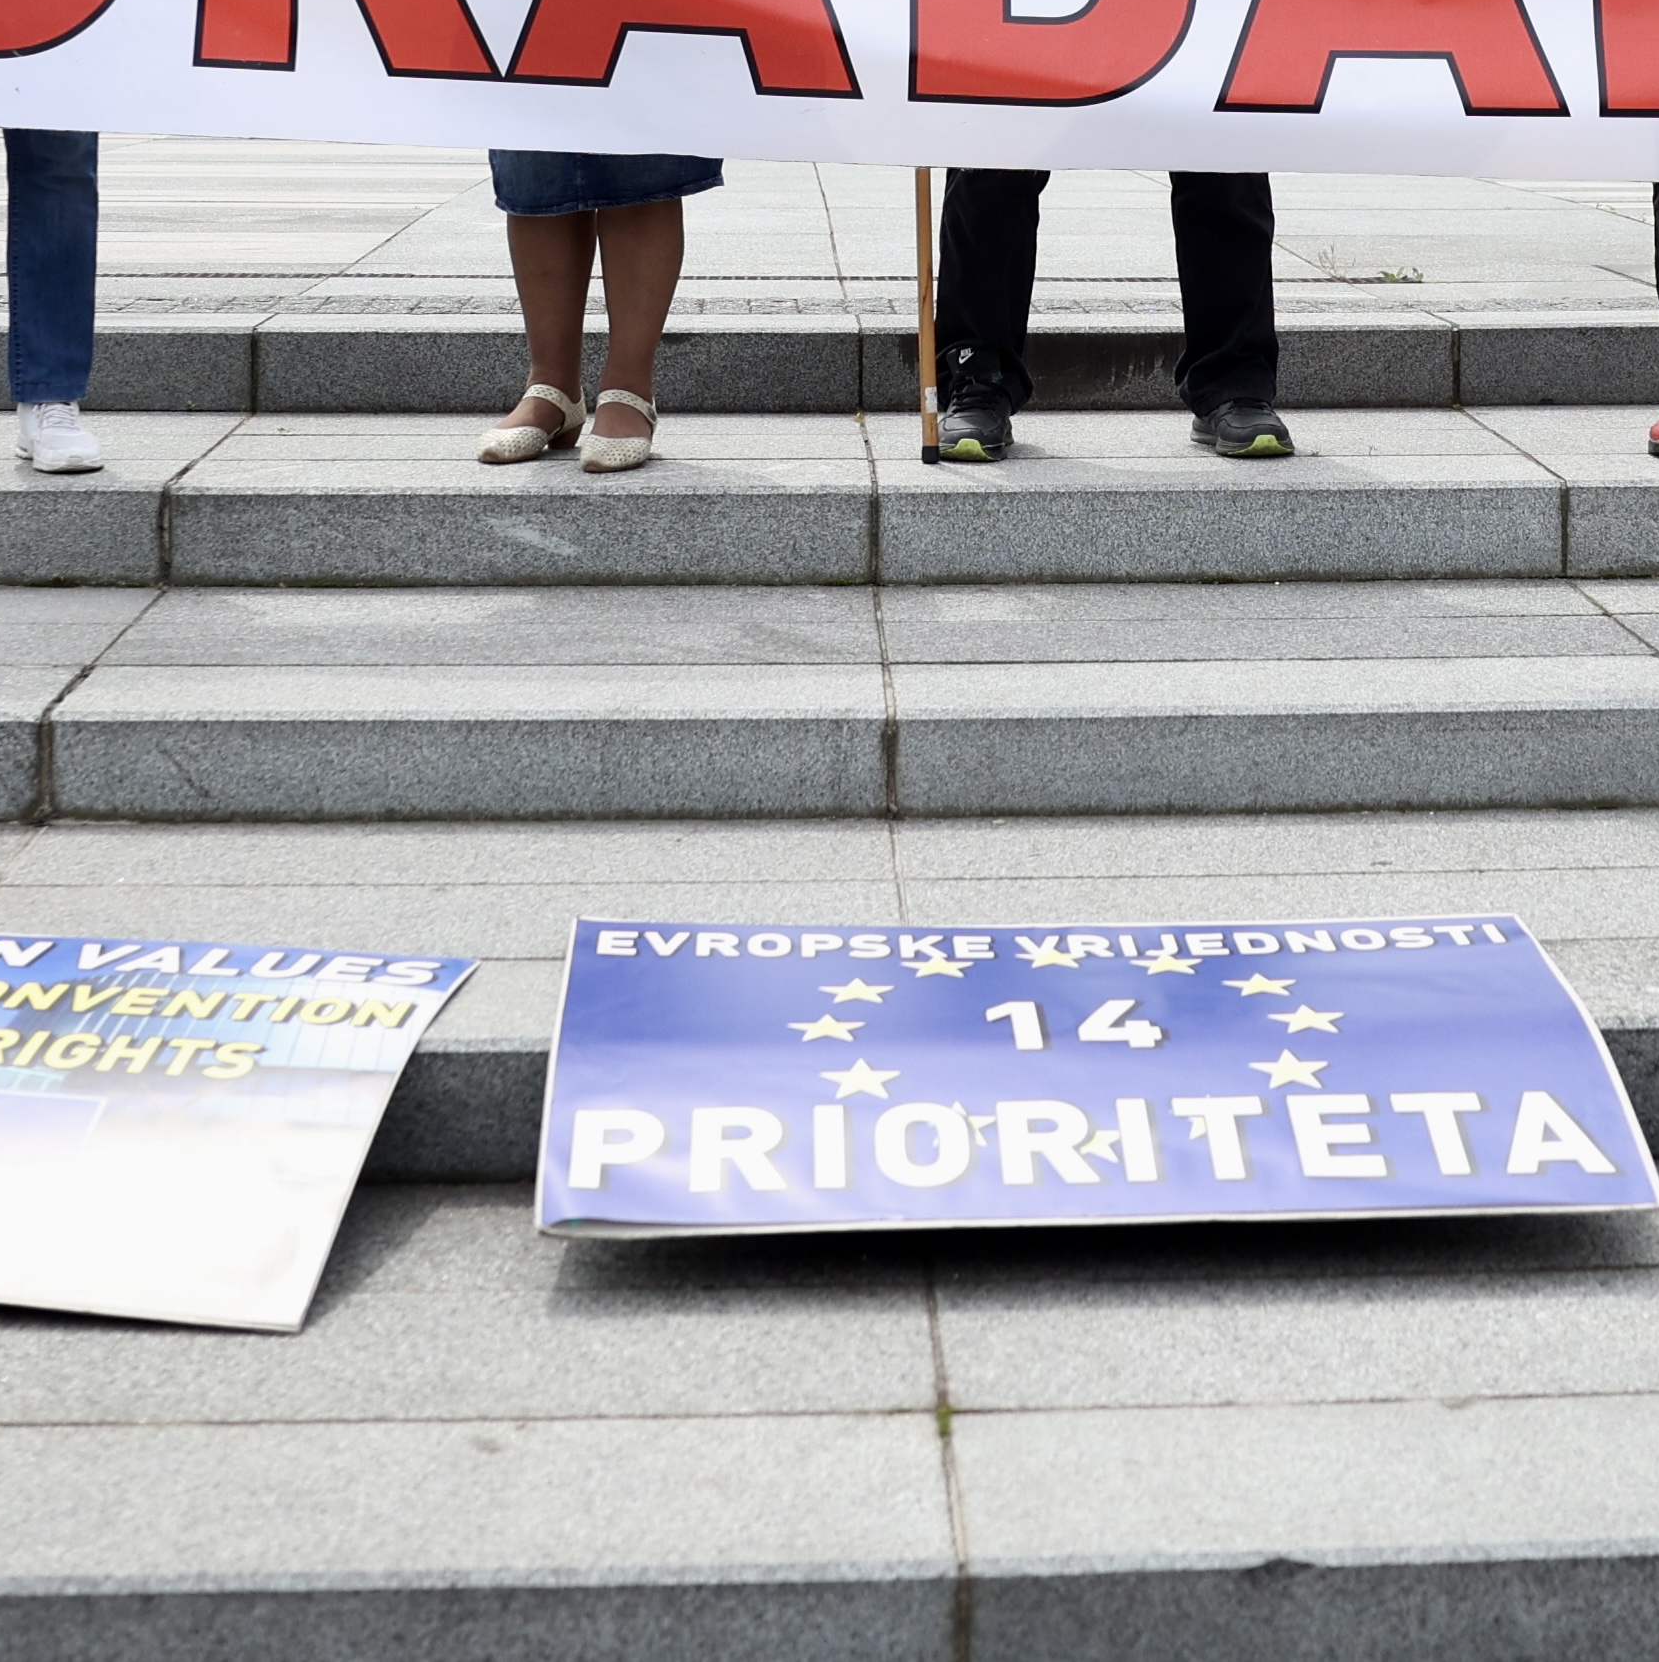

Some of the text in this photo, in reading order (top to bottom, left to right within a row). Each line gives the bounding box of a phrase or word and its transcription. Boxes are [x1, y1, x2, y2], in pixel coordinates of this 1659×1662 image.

[76, 942, 444, 987] VALUES
[596, 922, 1507, 960] EVROPSKE VRIJEDNOSTI
[985, 998, 1163, 1052] 14
[567, 1090, 1618, 1193] PRIORITETA
